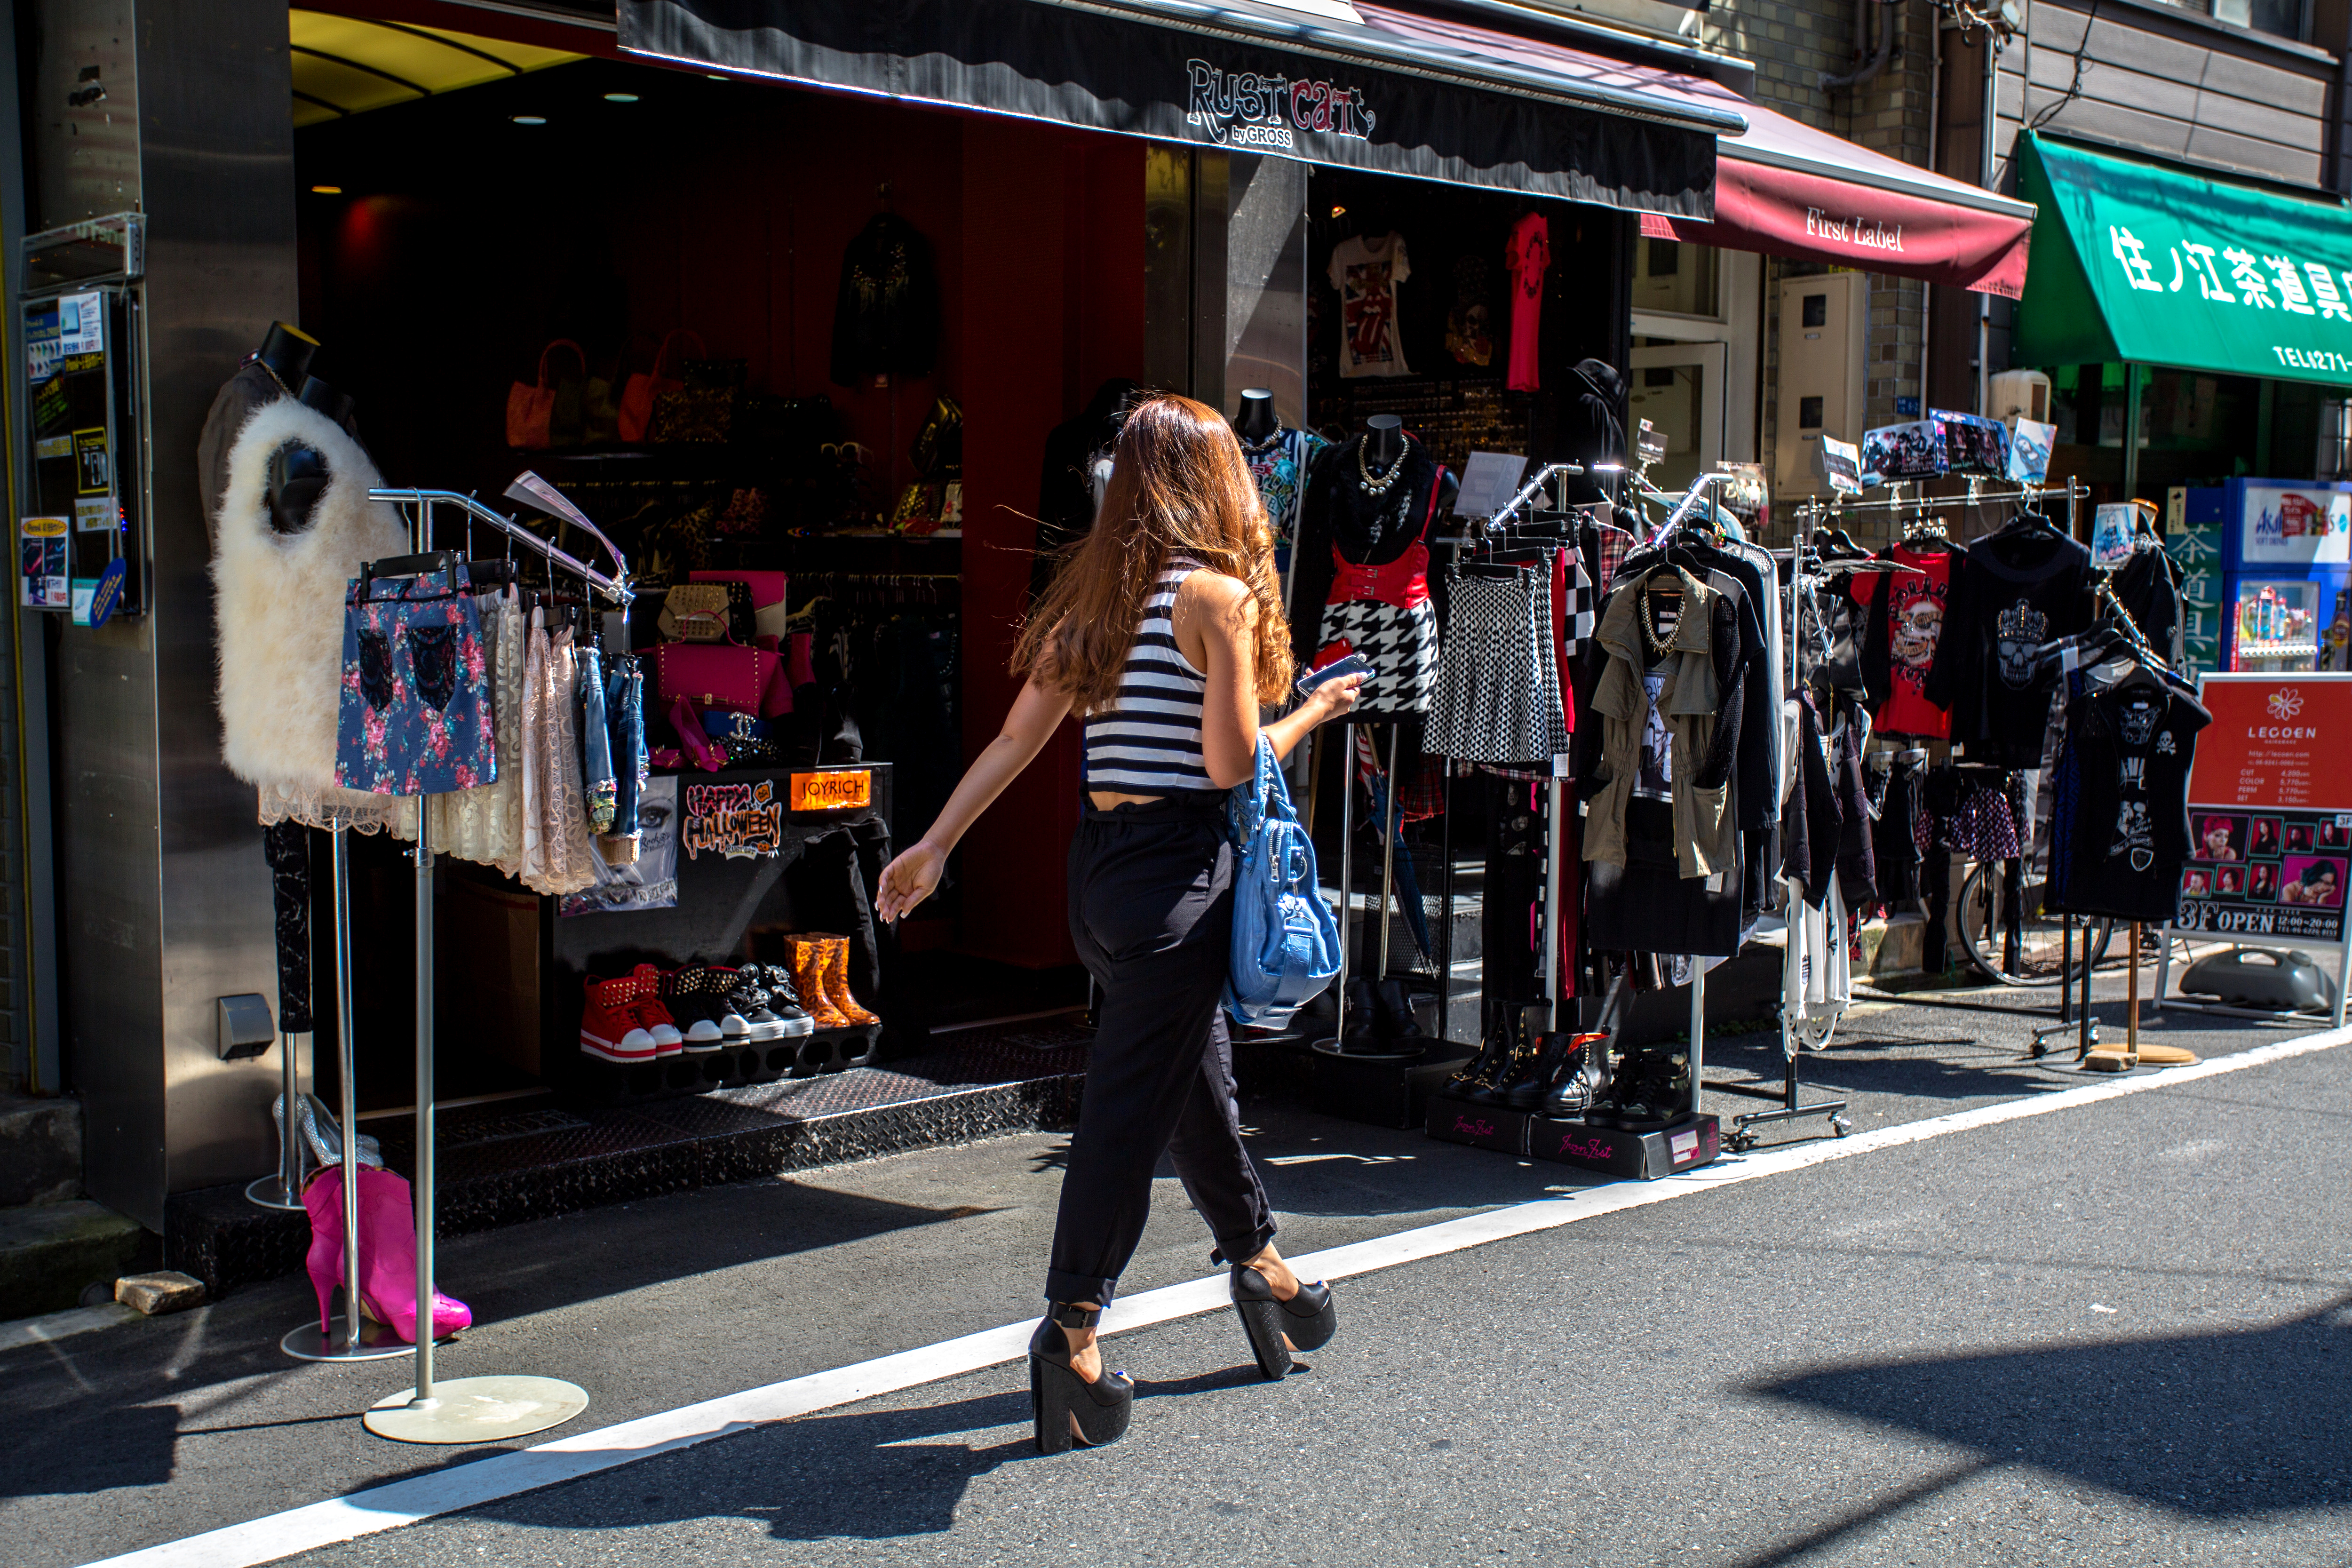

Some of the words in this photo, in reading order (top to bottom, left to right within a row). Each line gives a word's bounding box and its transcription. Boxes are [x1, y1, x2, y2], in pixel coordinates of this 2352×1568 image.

[1807, 207, 1849, 242] First
[1854, 216, 1904, 252] Label
[2110, 225, 2352, 322] 住ノ江茶道具
[1903, 516, 1945, 529] SALE
[687, 784, 751, 816] HAPPY
[803, 780, 864, 799] JOYRICH
[683, 802, 781, 860] HALLOWEEN
[2177, 899, 2220, 931] 3F
[2217, 910, 2275, 934] OPEN
[1453, 1115, 1476, 1133] Iron
[1475, 1119, 1494, 1136] Fist
[1558, 1134, 1589, 1156] Iron
[1588, 1138, 1613, 1159] Fist
